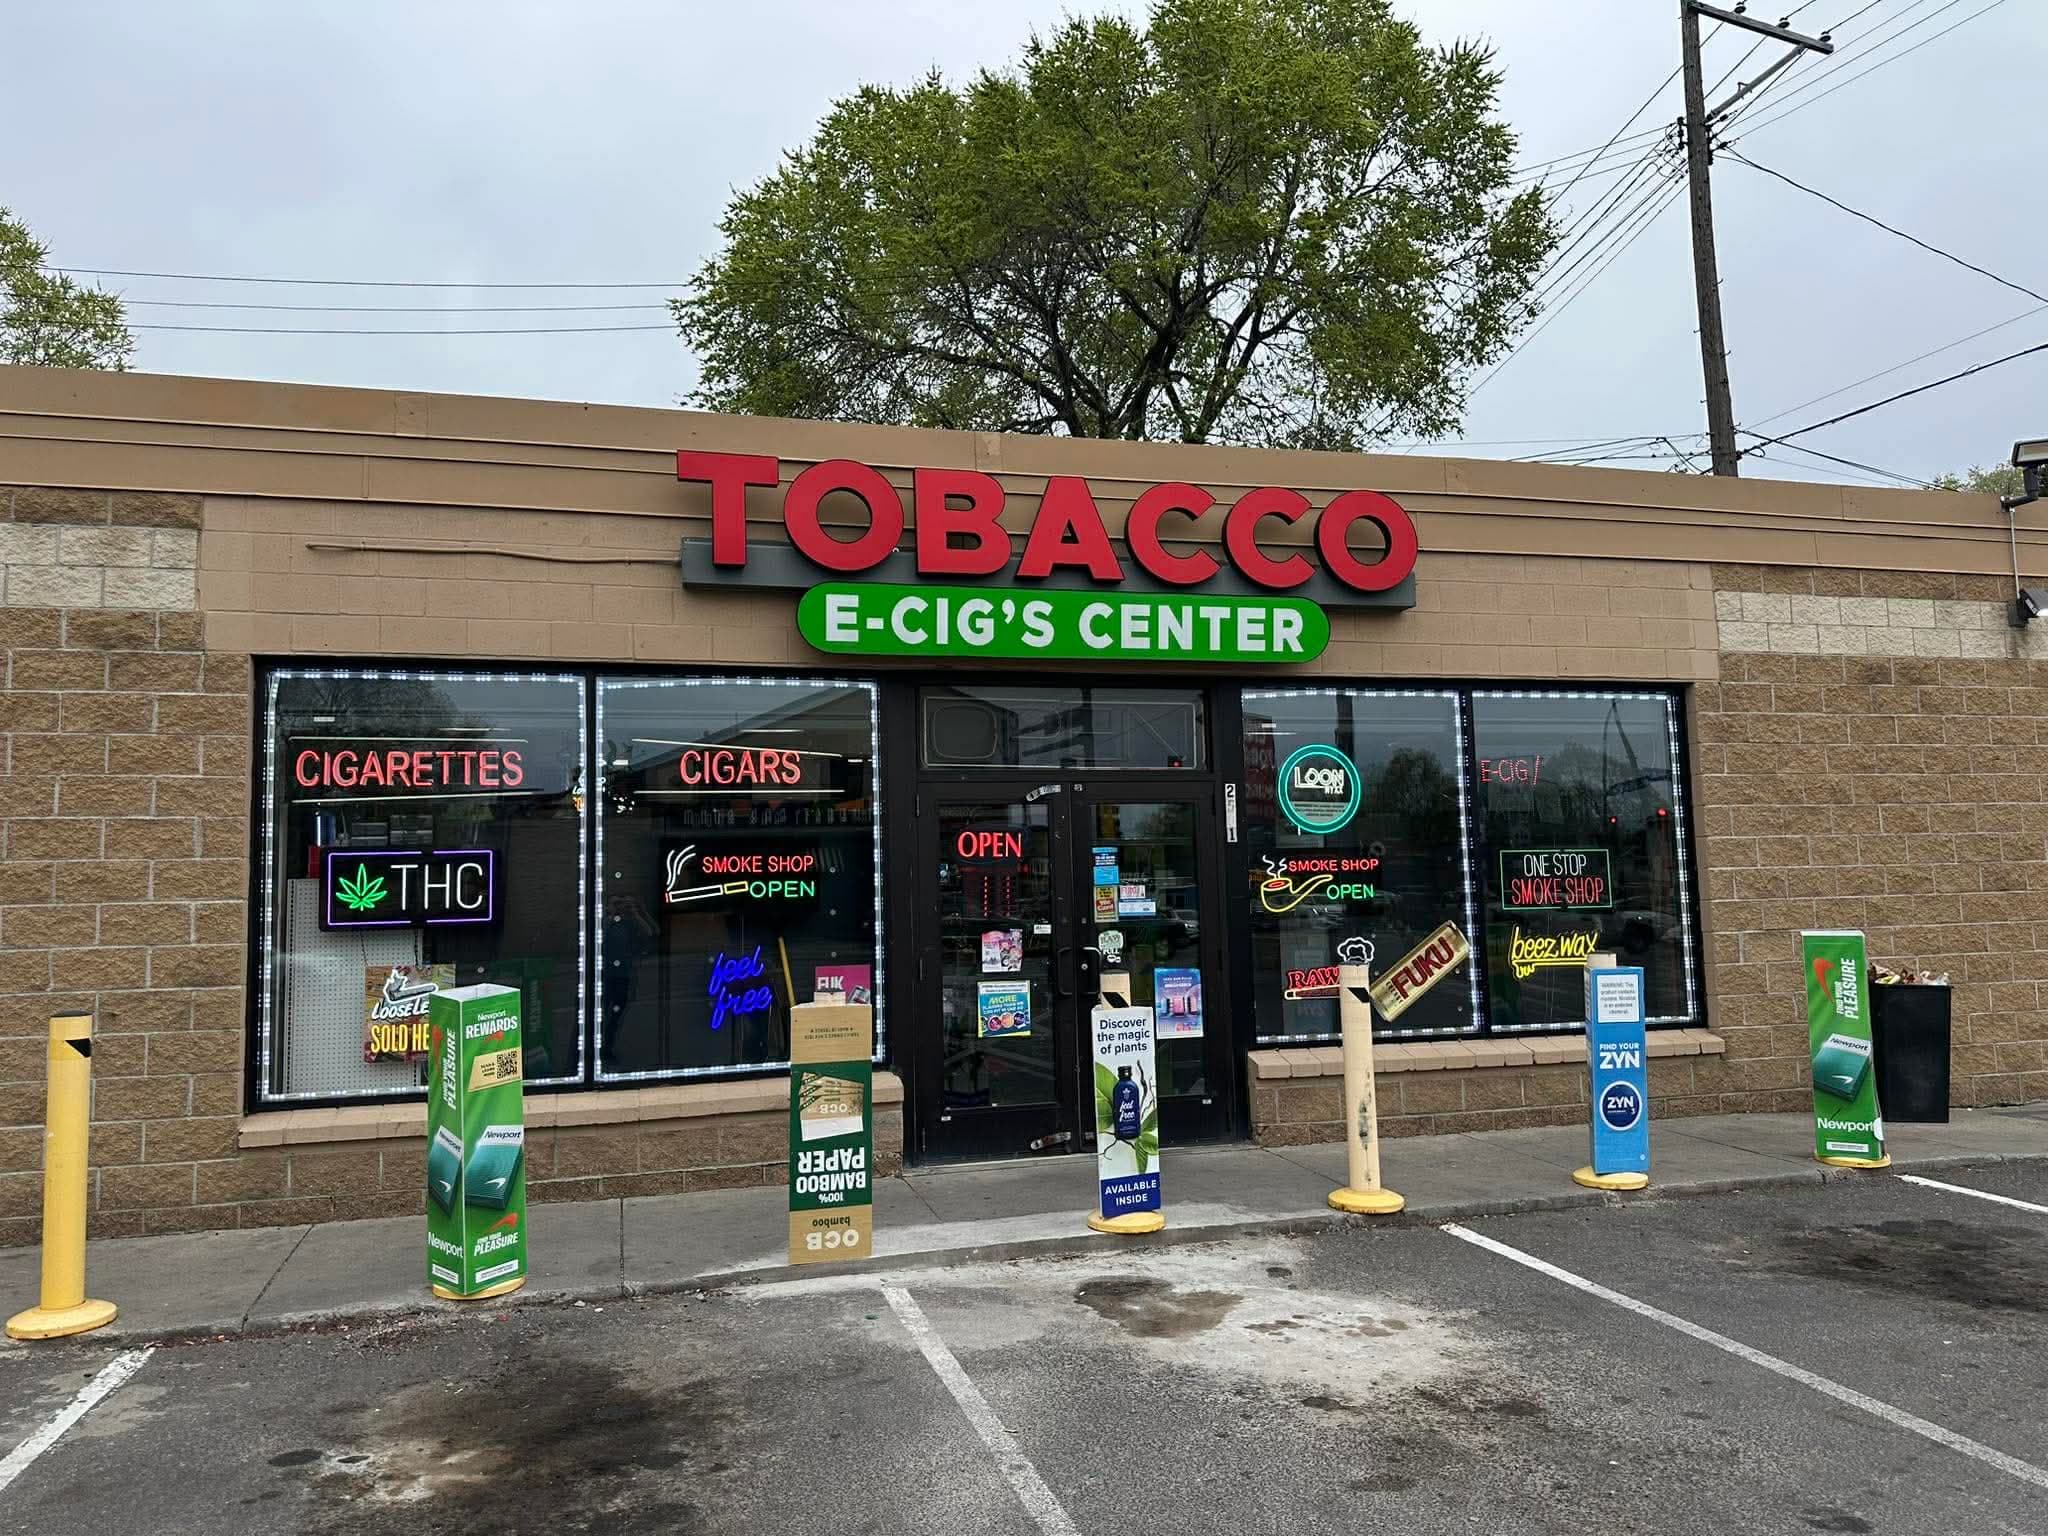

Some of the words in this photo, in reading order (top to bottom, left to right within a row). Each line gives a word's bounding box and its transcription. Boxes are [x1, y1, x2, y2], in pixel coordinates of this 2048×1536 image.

[677, 450, 1418, 591] TOBACCO
[826, 593, 1055, 648] E-CIG'S
[1079, 602, 1303, 653] CENTER
[296, 751, 523, 787] CIGARETTES
[680, 750, 800, 784] CIGARS
[1294, 766, 1344, 788] LOON
[1226, 784, 1236, 841] 21
[957, 831, 1022, 857] OPEN
[702, 855, 762, 873] SMOKE
[768, 855, 814, 873] SHOP
[1288, 859, 1338, 871] SMOKE
[1341, 858, 1379, 870] SHOP
[1523, 854, 1549, 878] ONE
[1553, 853, 1586, 876] STOP
[390, 863, 483, 911] THC
[750, 880, 815, 898] OPEN
[1327, 884, 1374, 899] OPEN
[1511, 878, 1561, 905] SMOKE
[1565, 877, 1604, 904] SHOP
[1512, 927, 1558, 959] beez
[1559, 932, 1598, 957] wax
[709, 945, 765, 995] feel
[1287, 966, 1340, 989] RAW
[1391, 936, 1456, 1000] FUKU
[1841, 958, 1858, 1019] PLEASURE
[478, 1010, 506, 1021] Newport
[711, 985, 773, 1029] free
[465, 1016, 518, 1039] REWARDS
[1100, 1018, 1147, 1030] Discover
[371, 1023, 408, 1053] SOLD
[412, 1023, 430, 1050] HE
[1097, 1030, 1116, 1042] the
[1118, 1028, 1150, 1043] magic
[1619, 1042, 1640, 1050] YOUR
[1830, 1036, 1869, 1051] Newport
[1100, 1043, 1112, 1055] of
[1114, 1041, 1147, 1056] plants
[446, 1028, 456, 1110] PLEASURE
[1600, 1051, 1640, 1069] ZYN
[820, 1103, 848, 1114] OCB
[1119, 1100, 1134, 1112] feel
[1608, 1096, 1634, 1108] ZYN
[1119, 1110, 1135, 1122] free
[1817, 1117, 1875, 1134] Newport
[484, 1129, 521, 1140] Newport
[798, 1147, 865, 1174] PAPER
[796, 1171, 866, 1194] BAMBOO
[1104, 1178, 1157, 1196] AVAILABLE
[818, 1192, 844, 1204] 100%
[1115, 1193, 1148, 1207] INSIDE
[812, 1215, 851, 1227] bamboo
[428, 1231, 464, 1259] Newport
[473, 1231, 519, 1257] PLEASURE
[806, 1228, 859, 1250] OCB
